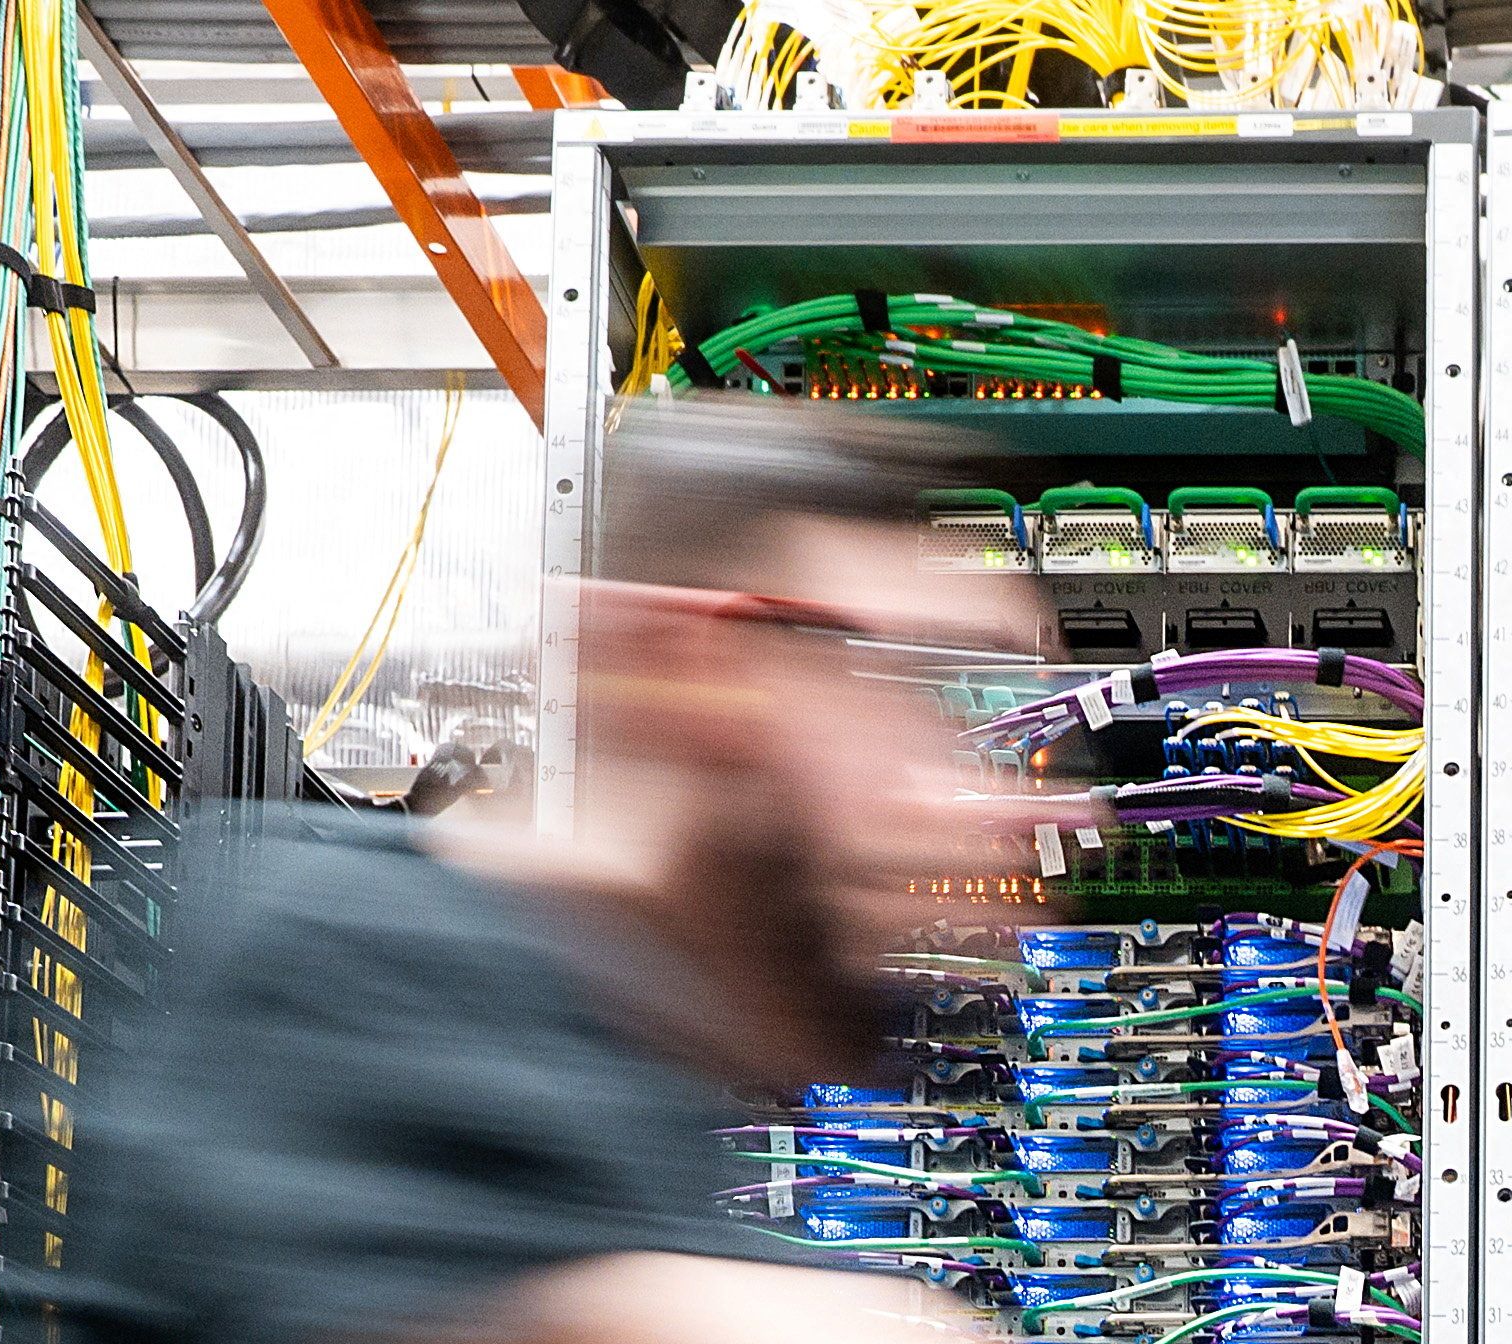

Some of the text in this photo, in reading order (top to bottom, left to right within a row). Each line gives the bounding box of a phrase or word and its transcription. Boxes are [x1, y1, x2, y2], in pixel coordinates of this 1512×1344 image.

[1081, 123, 1108, 133] care
[1113, 121, 1141, 132] when
[1146, 121, 1199, 135] removing
[1202, 120, 1235, 131] items
[550, 499, 563, 515] 43
[547, 565, 561, 581] 42
[545, 632, 557, 647] 41
[544, 699, 558, 714] 40
[542, 765, 556, 780] 39
[1491, 760, 1505, 776] 39
[1452, 966, 1466, 982] 36
[1490, 962, 1504, 978] 36
[1489, 1169, 1503, 1185] 33
[1451, 1239, 1465, 1255] 32
[1489, 1237, 1503, 1253] 32
[1489, 1308, 1503, 1324] 31
